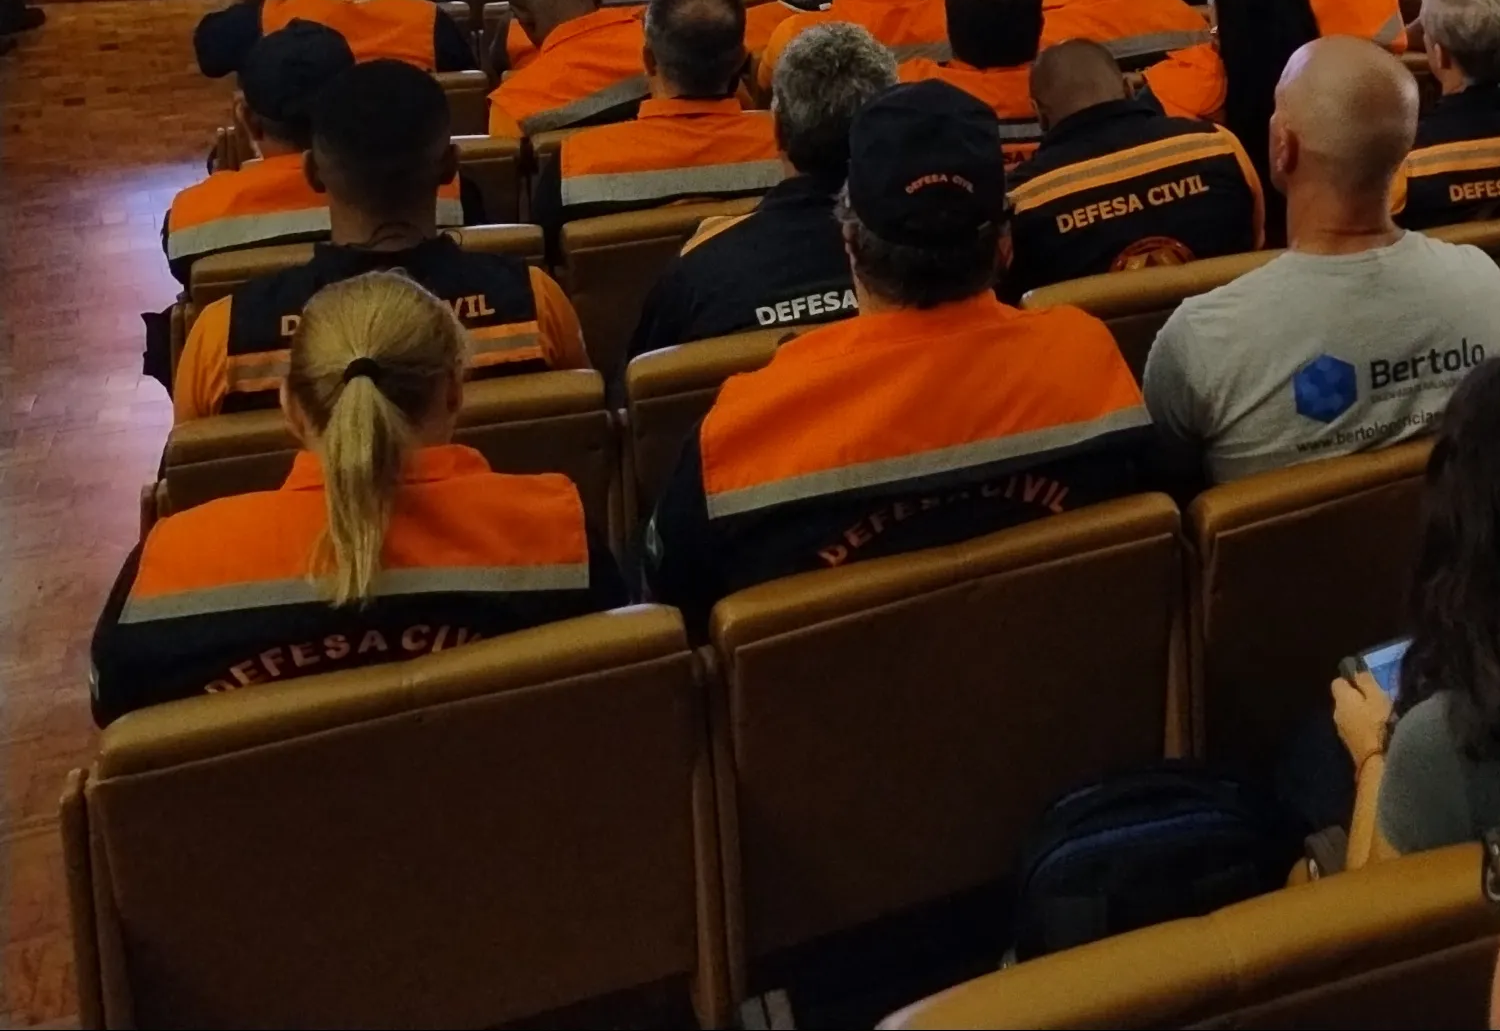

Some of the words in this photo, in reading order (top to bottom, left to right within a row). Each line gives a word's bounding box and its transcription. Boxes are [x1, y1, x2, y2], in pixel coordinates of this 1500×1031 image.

[905, 173, 948, 194] DEFESA
[1055, 193, 1144, 234] DEFESA
[1147, 174, 1210, 206] CIVIL
[441, 294, 496, 319] VIL
[755, 289, 859, 326] DEFESA
[1370, 337, 1485, 390] Bertolo
